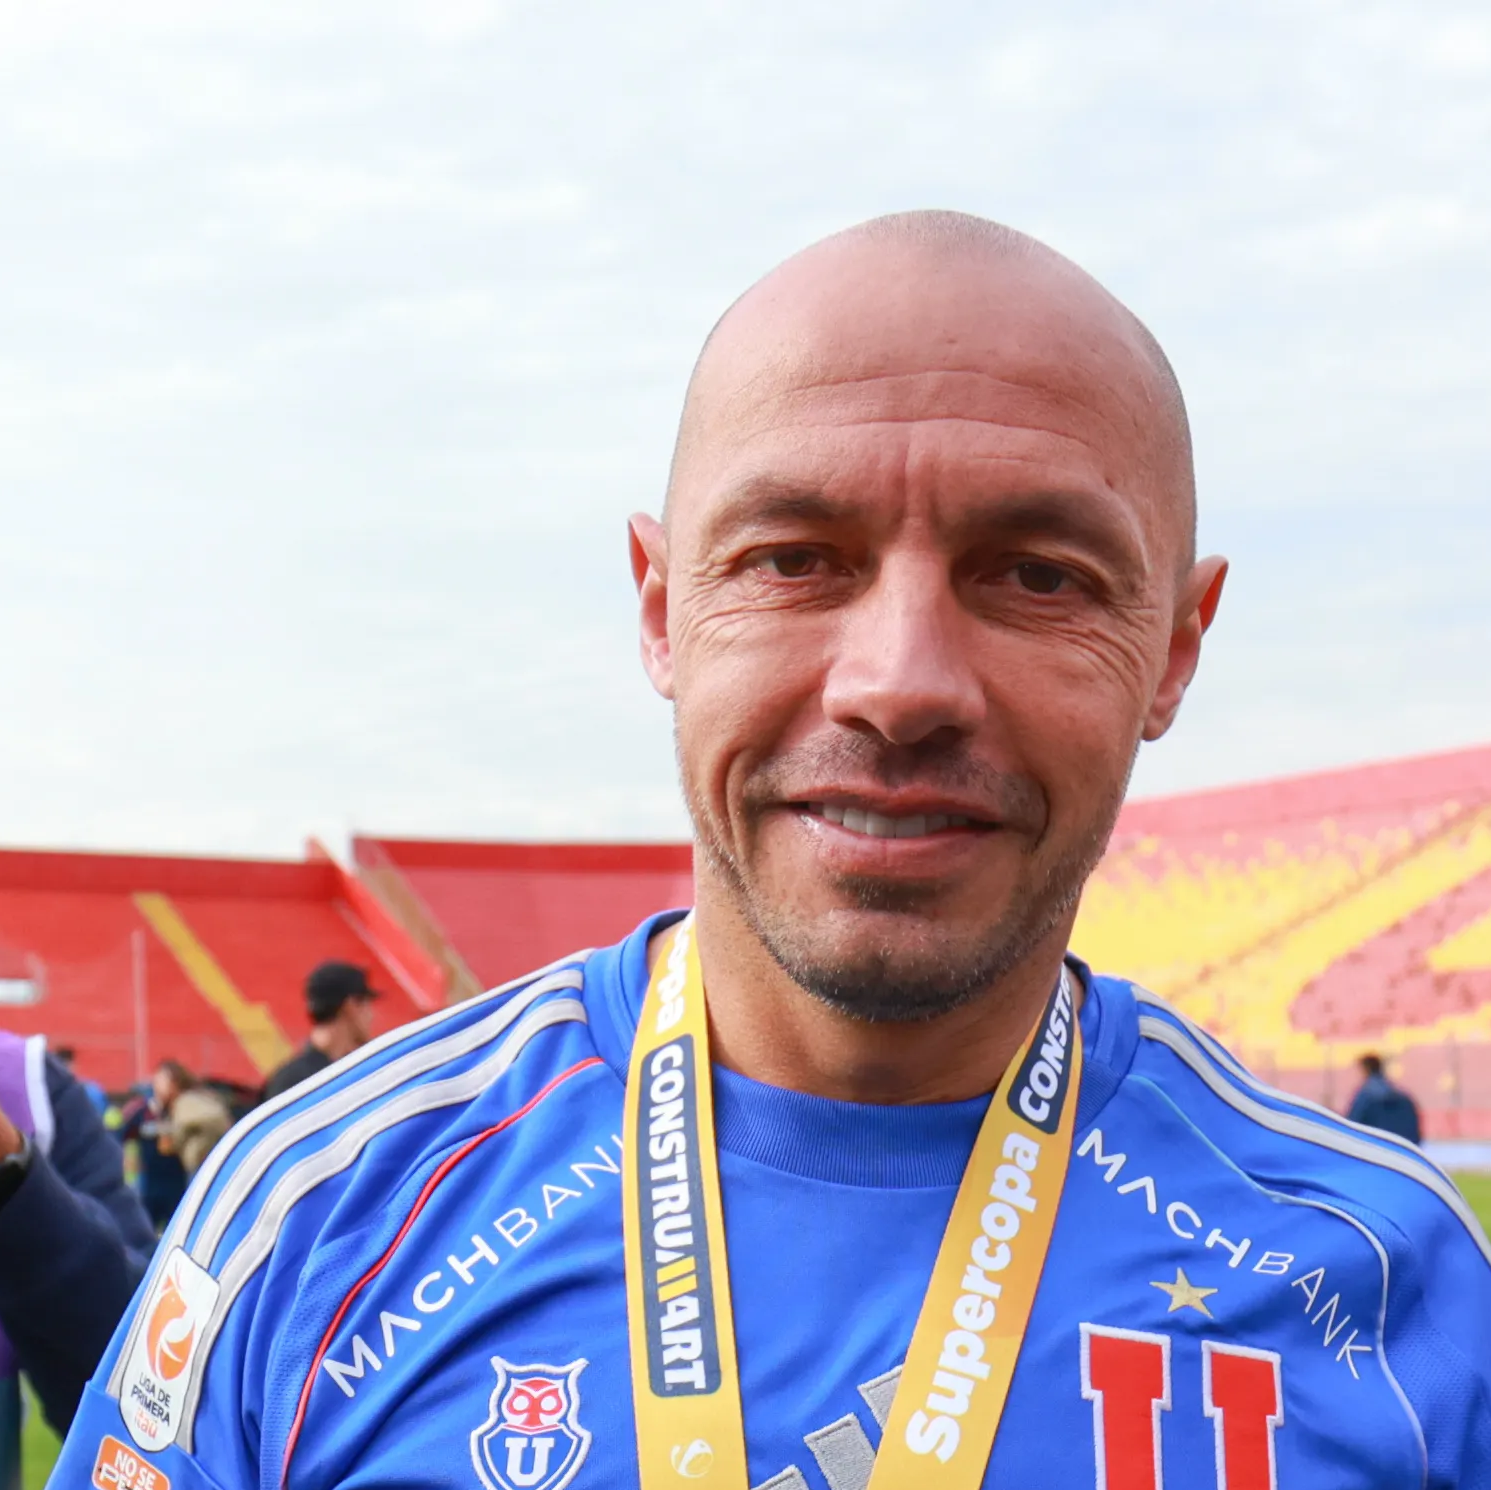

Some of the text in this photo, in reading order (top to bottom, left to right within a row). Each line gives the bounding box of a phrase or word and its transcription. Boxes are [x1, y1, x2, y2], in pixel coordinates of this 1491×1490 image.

[323, 1133, 624, 1398] MACHBAN
[1076, 1128, 1372, 1381] MACHBANK
[906, 1131, 1042, 1464] Supercopa
[130, 1384, 171, 1428] PRIMERA
[158, 1386, 172, 1408] DE
[114, 1449, 137, 1477] NO
[505, 1437, 555, 1486] U
